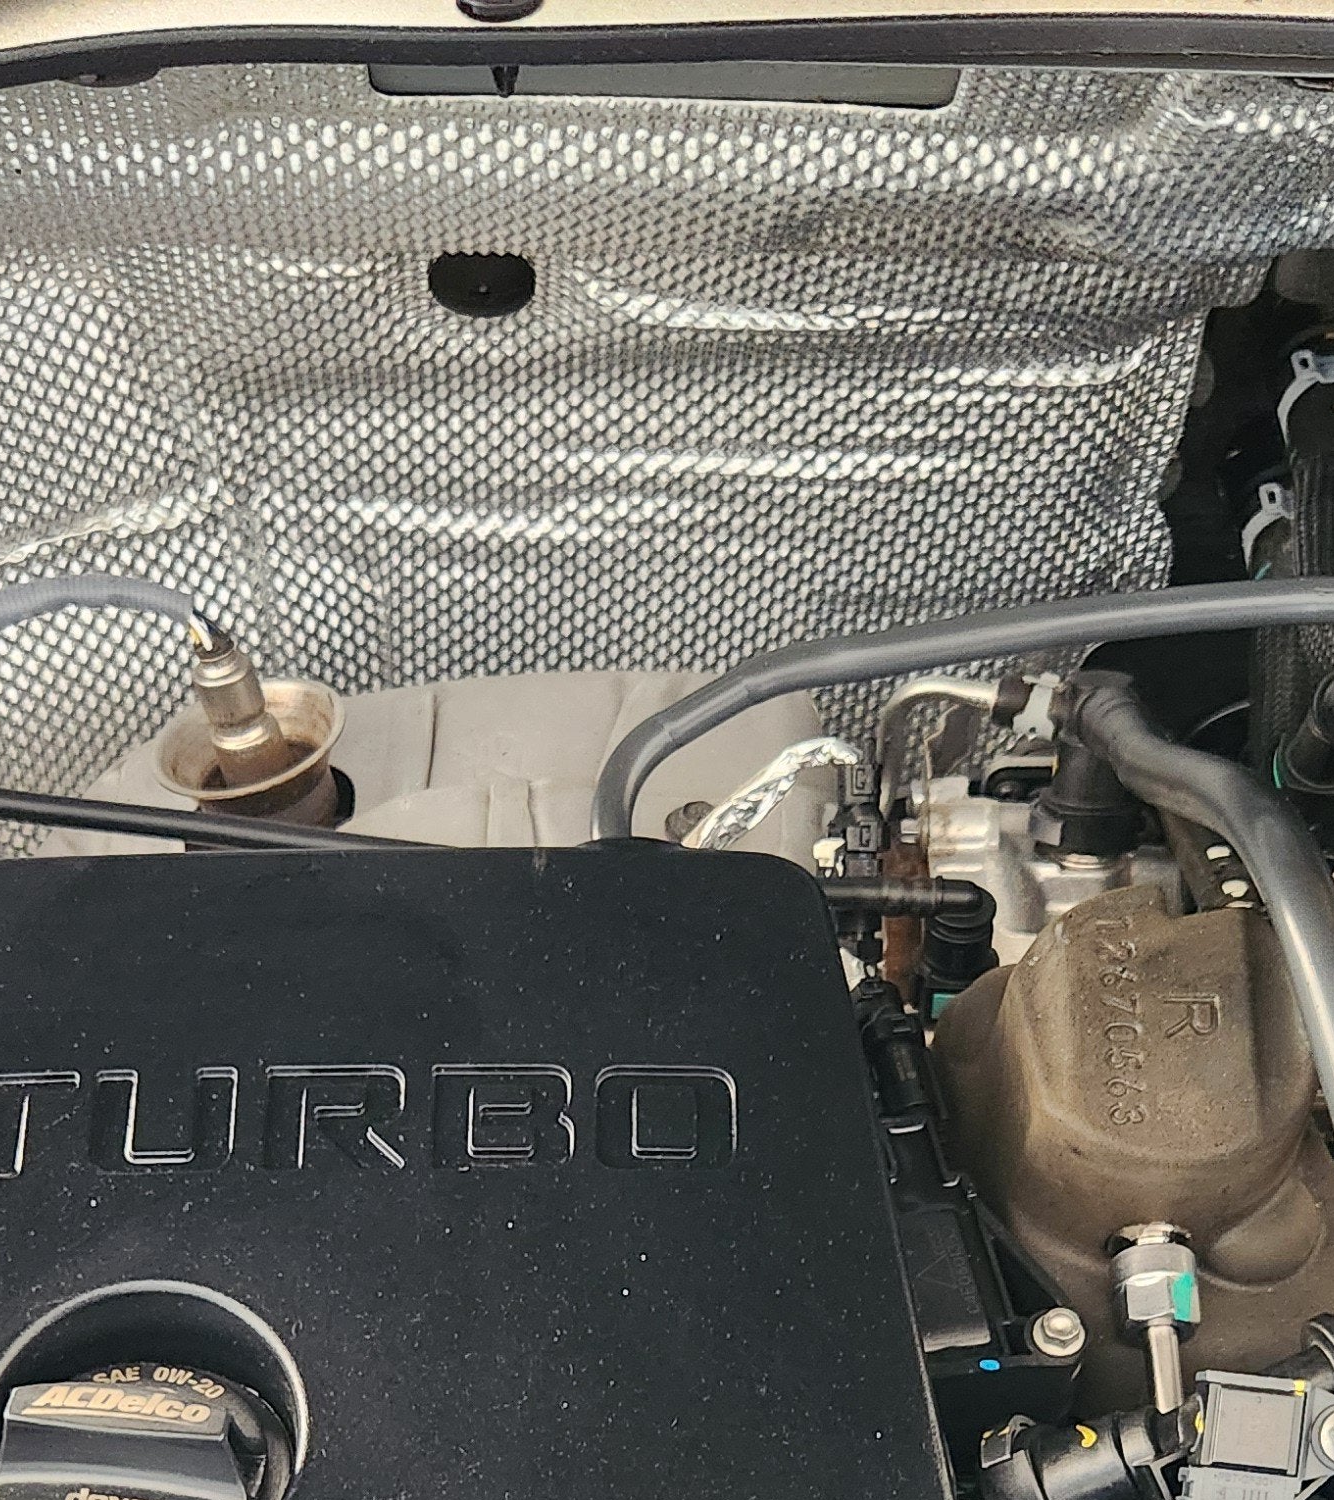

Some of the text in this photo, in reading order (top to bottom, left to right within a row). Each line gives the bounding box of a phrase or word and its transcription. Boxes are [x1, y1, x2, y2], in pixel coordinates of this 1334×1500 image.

[1164, 993, 1221, 1040] R
[92, 1366, 225, 1399] SAE 0W-20
[31, 1386, 211, 1423] ACDelco
